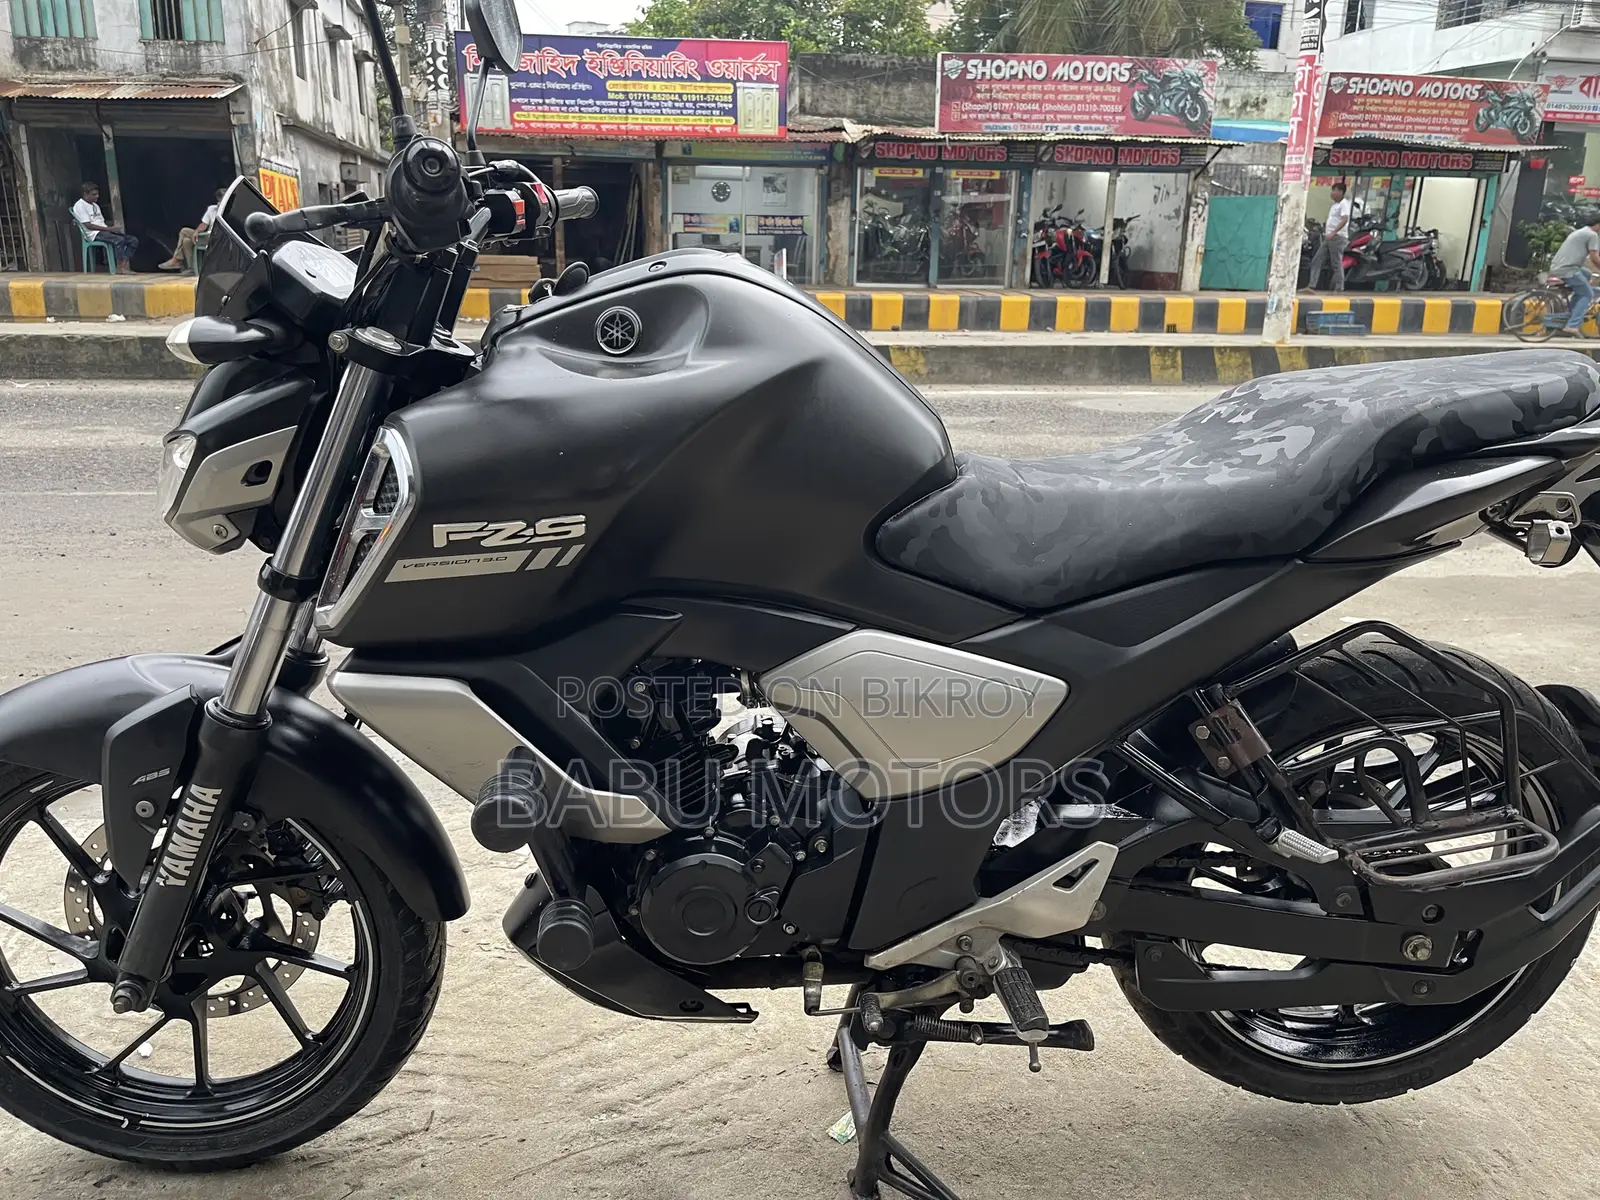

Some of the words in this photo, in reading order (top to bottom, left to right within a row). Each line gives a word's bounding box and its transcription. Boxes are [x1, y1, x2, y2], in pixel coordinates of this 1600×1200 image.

[966, 59, 1048, 81] SHOPNO
[1051, 60, 1134, 82] MOTORS
[1346, 77, 1414, 97] SHOPNO
[1416, 81, 1485, 101] MOTORS
[875, 142, 938, 160] SHOPNO
[942, 144, 1008, 162] MOTORS
[1054, 144, 1116, 165] SHOPNO
[1118, 147, 1180, 166] MOTORS
[1328, 148, 1399, 168] SHOPNO
[1400, 150, 1474, 170] MOTORS
[433, 514, 586, 548] FZS
[402, 558, 480, 569] VERSION
[155, 784, 223, 887] YAMAHA
